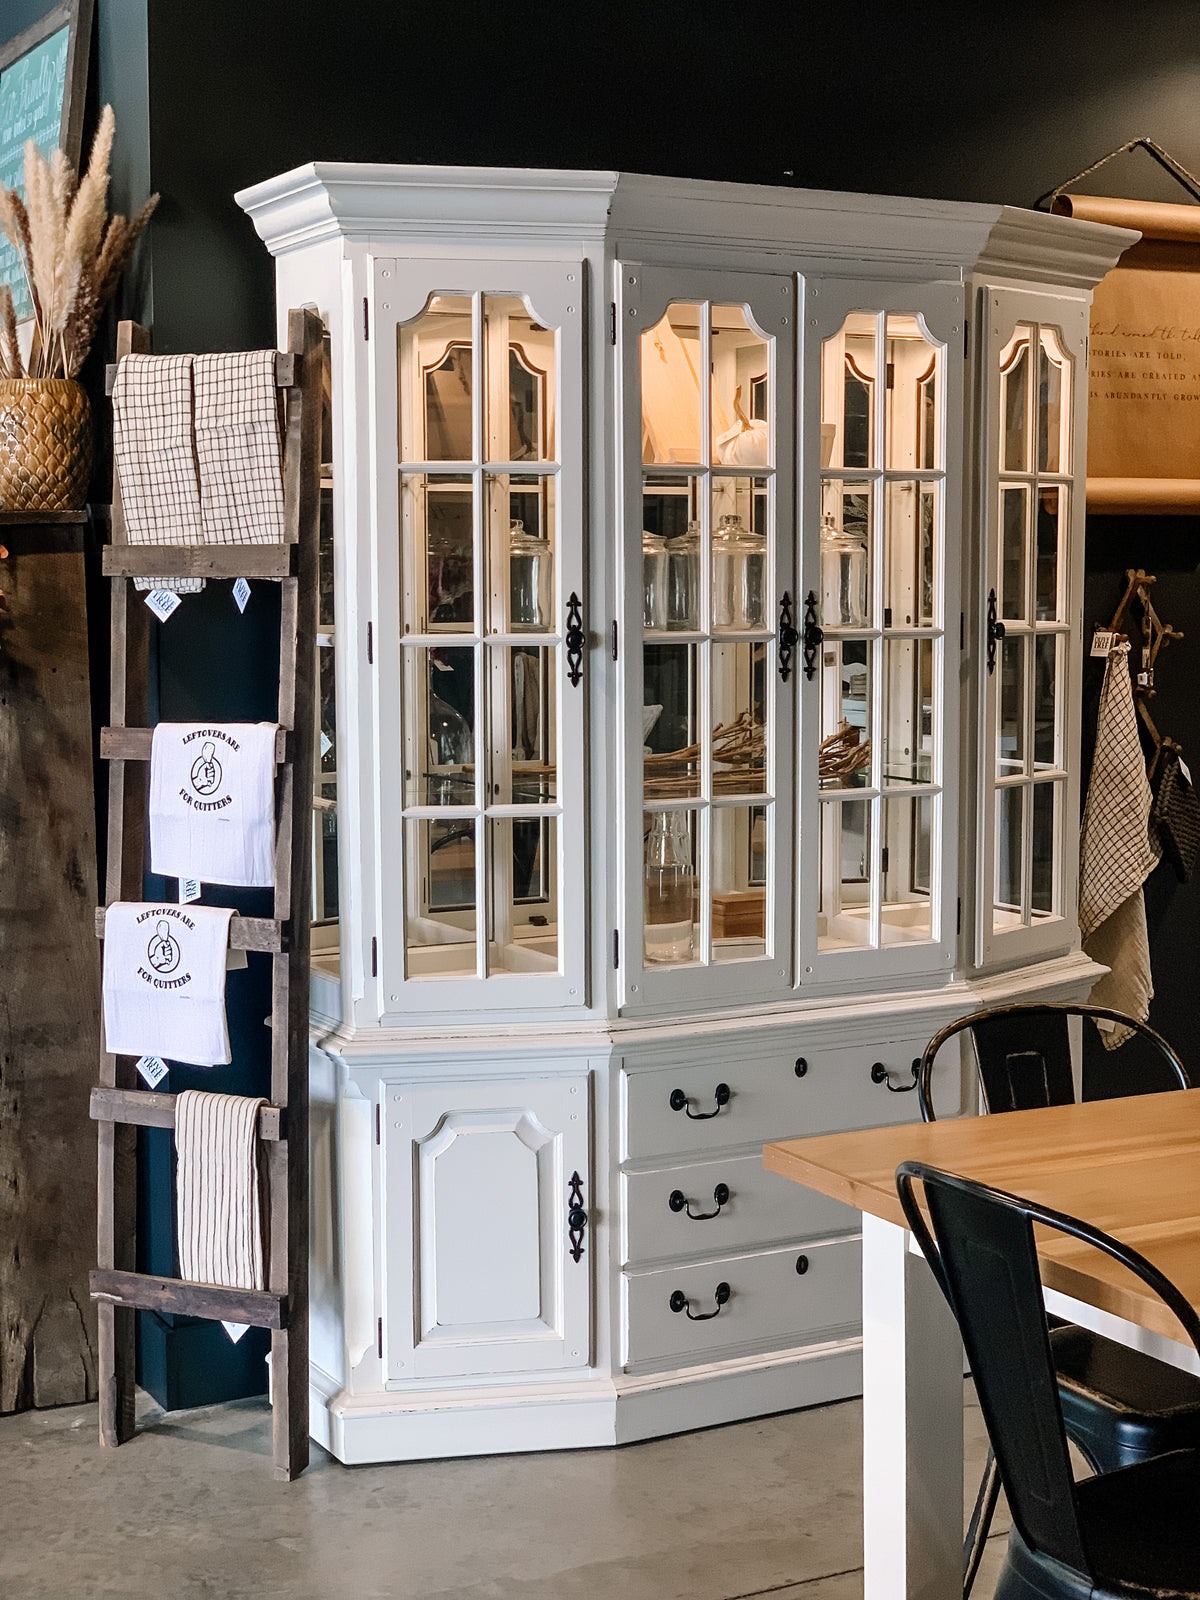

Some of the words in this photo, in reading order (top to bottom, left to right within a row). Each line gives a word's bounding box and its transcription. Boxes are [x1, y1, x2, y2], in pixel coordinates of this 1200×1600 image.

[1089, 349, 1127, 358] TORIES
[1133, 351, 1152, 360] ARE
[1089, 370, 1112, 379] RIES
[1118, 370, 1137, 379] ARE
[1142, 371, 1186, 381] CREATED
[1105, 391, 1168, 401] ABUNDANTLY
[182, 729, 227, 745] LEFTOVERS
[225, 737, 241, 752] ARE
[179, 788, 193, 806] FOR
[193, 794, 233, 812] QUITTERS
[136, 908, 182, 925] LEFTOVERS
[180, 915, 196, 931] ARE
[137, 967, 152, 984] FOR
[153, 972, 192, 989] QUITTERS
